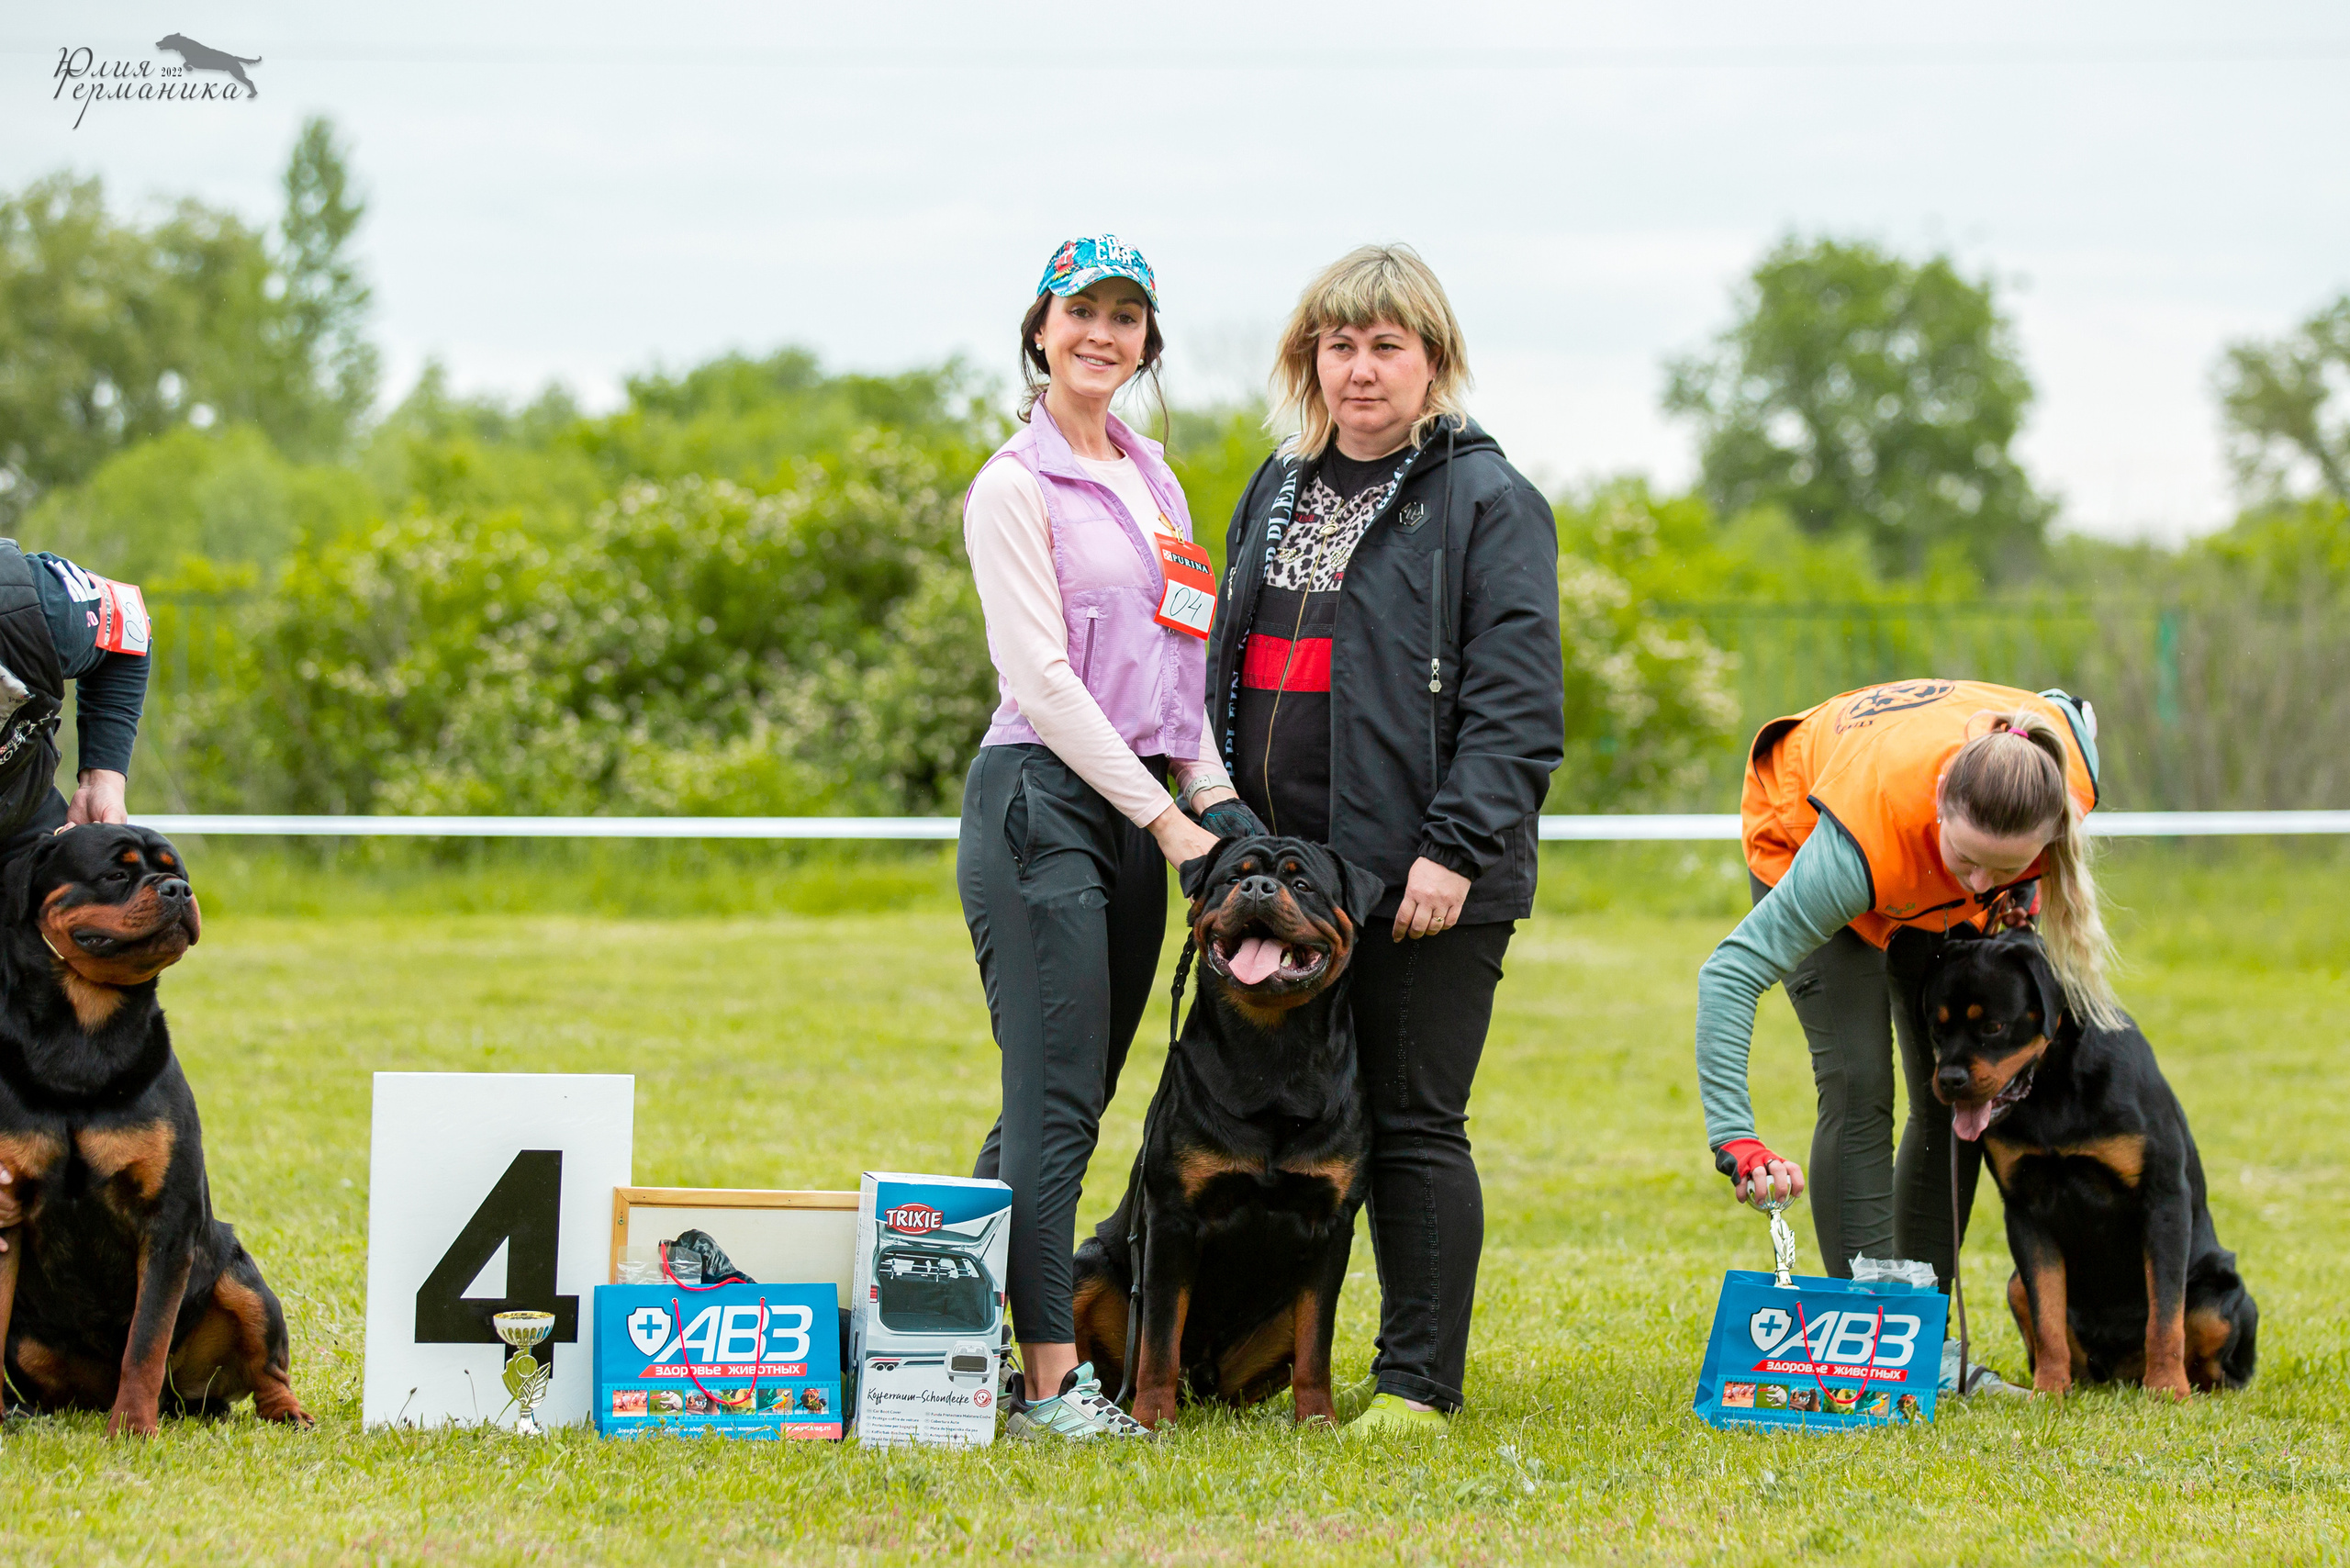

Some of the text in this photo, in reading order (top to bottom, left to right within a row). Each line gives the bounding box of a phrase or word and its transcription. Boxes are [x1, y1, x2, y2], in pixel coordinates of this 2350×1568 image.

[1172, 553, 1209, 574] PURINA
[1169, 587, 1203, 622] 04
[886, 1209, 942, 1228] TRIXIE
[414, 1149, 580, 1379] 4
[653, 1305, 813, 1362] АВЗ
[1766, 1311, 1921, 1367] АВЗ
[867, 1387, 970, 1406] Kofferraum-Schondecke
